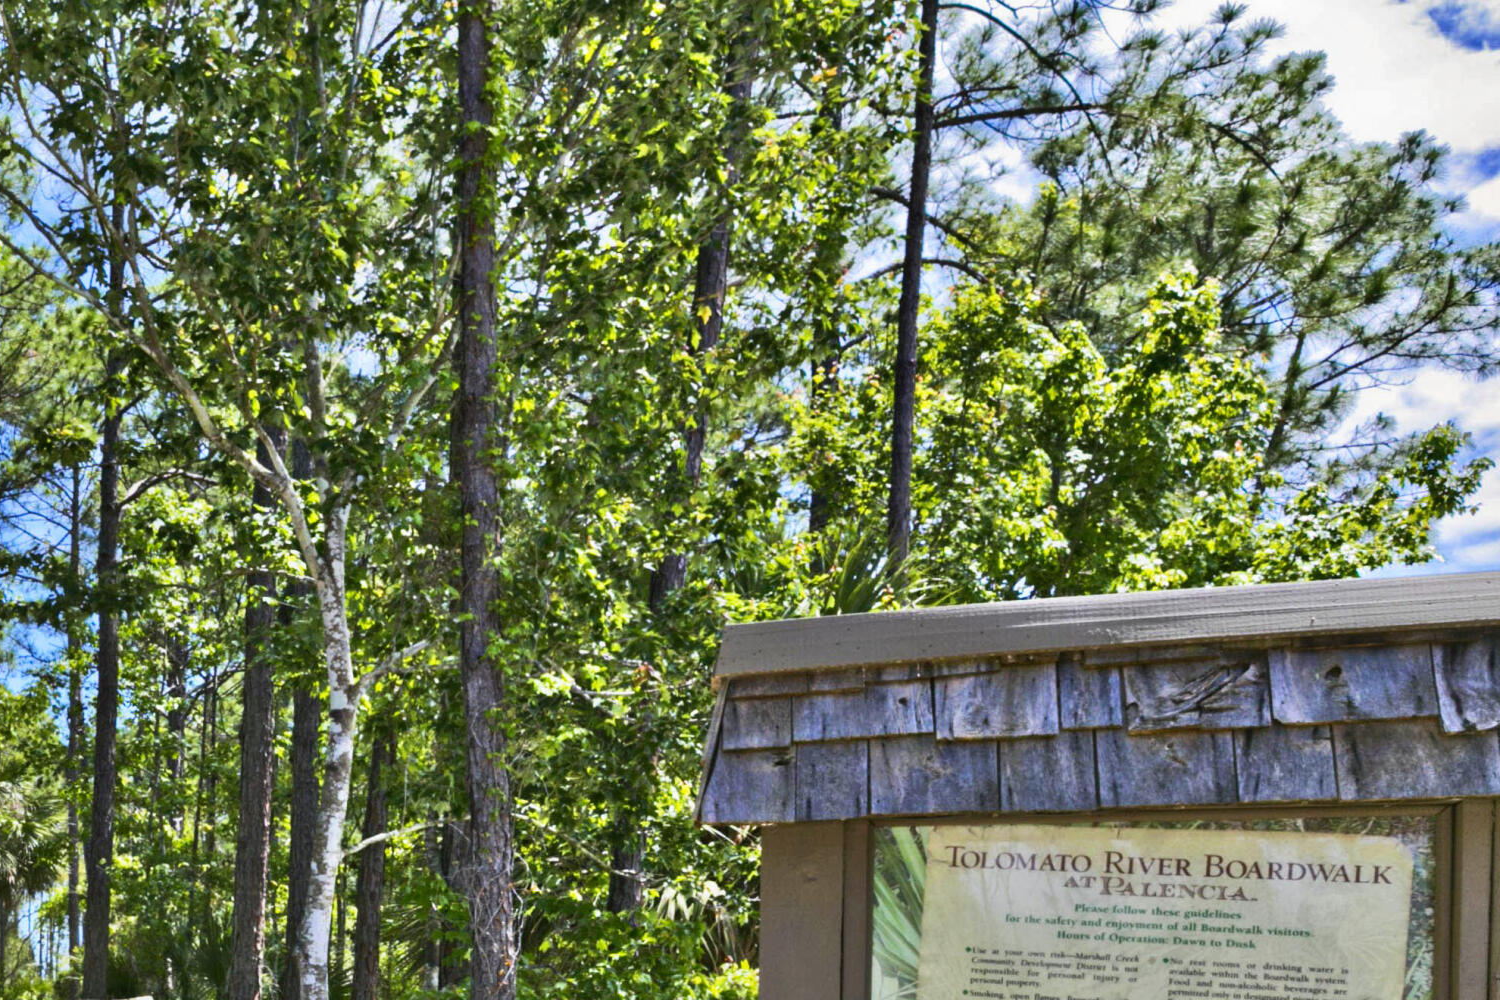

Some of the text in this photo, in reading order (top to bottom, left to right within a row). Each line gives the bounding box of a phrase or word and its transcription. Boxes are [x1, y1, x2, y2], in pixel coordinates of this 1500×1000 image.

[945, 845, 1393, 884] TOLOMATO RIVER BOARDWALK
[1063, 876, 1097, 888] AT
[1074, 903, 1242, 920] Please follow these guidelines
[1005, 913, 1315, 938] for the safety and enjoyment of all Boardwalk visitors.
[1057, 930, 1257, 949] Hours of Operation: Dawn to Dusk
[1115, 954, 1139, 962] Creek
[970, 966, 1019, 977] responsible
[1027, 969, 1039, 977] for
[1047, 971, 1085, 981] personal
[1093, 974, 1119, 983] injury
[1169, 967, 1205, 976] available
[1212, 970, 1238, 978] within
[1263, 973, 1309, 982] Boardwalk
[1264, 963, 1301, 973] drinking
[969, 976, 1003, 986] personal
[1168, 978, 1190, 986] Food
[1197, 979, 1213, 987] and
[1219, 981, 1276, 991] non-alcoholic
[1284, 985, 1327, 995] beverages
